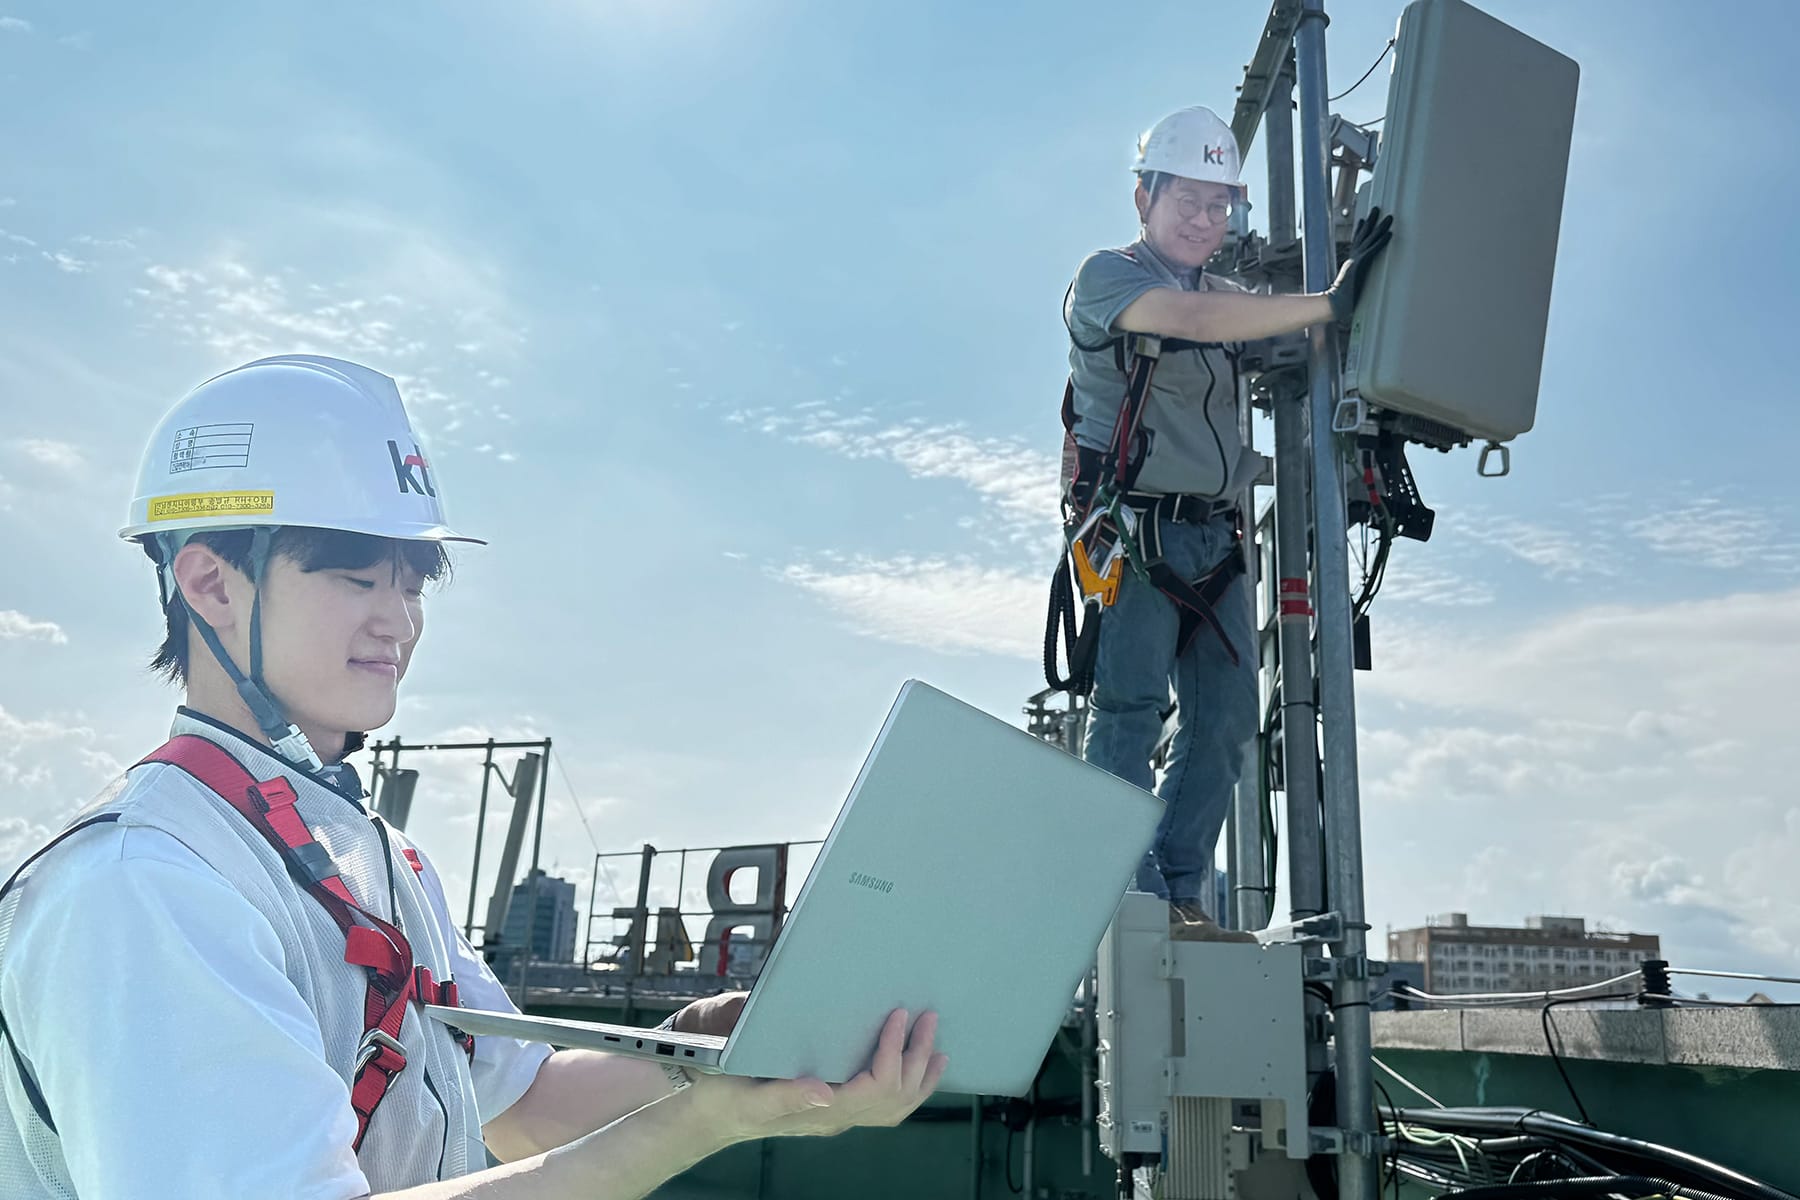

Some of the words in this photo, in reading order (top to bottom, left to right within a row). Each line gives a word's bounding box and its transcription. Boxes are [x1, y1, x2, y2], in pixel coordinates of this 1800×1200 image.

[1204, 145, 1224, 165] kt
[387, 440, 436, 498] kt
[849, 872, 893, 894] SAMSUNG
